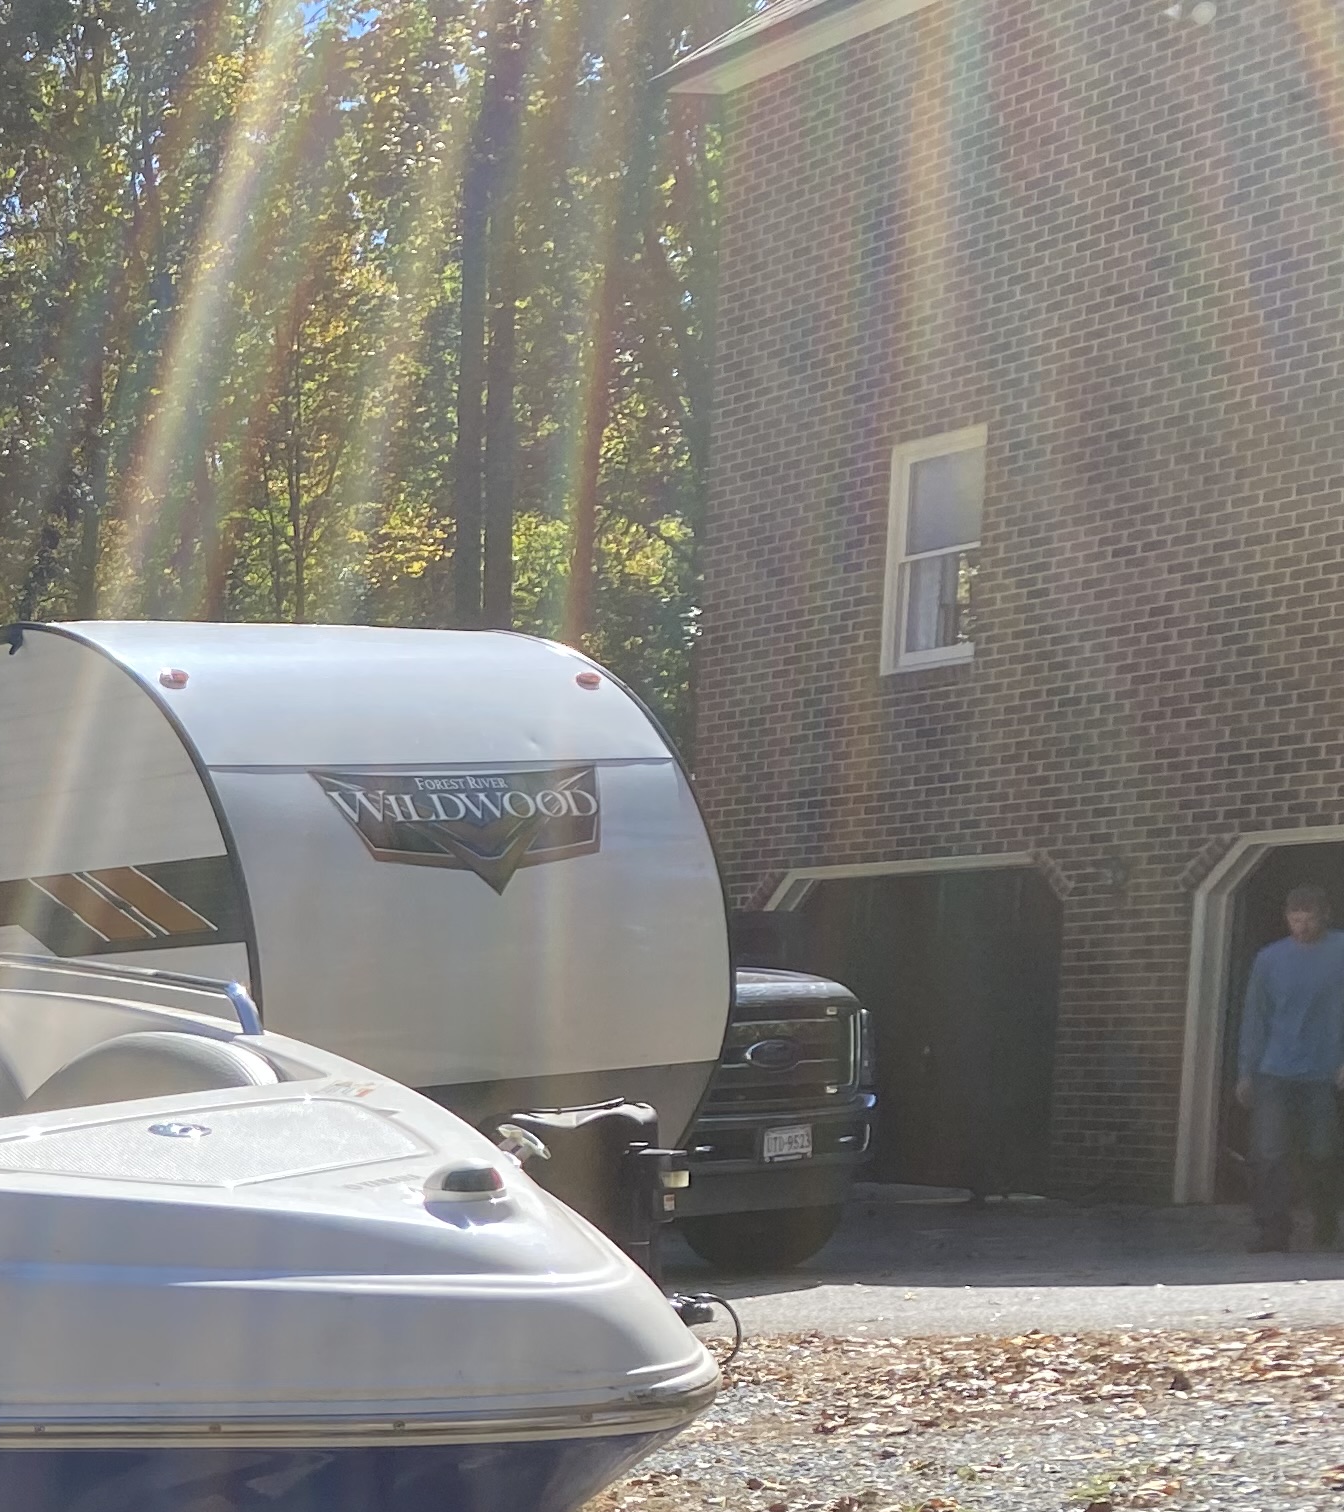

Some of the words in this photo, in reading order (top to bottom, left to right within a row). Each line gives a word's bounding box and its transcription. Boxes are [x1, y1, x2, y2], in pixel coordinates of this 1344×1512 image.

[415, 777, 464, 791] FOREST
[466, 775, 509, 790] RIVER
[326, 789, 599, 824] WILDWOOD
